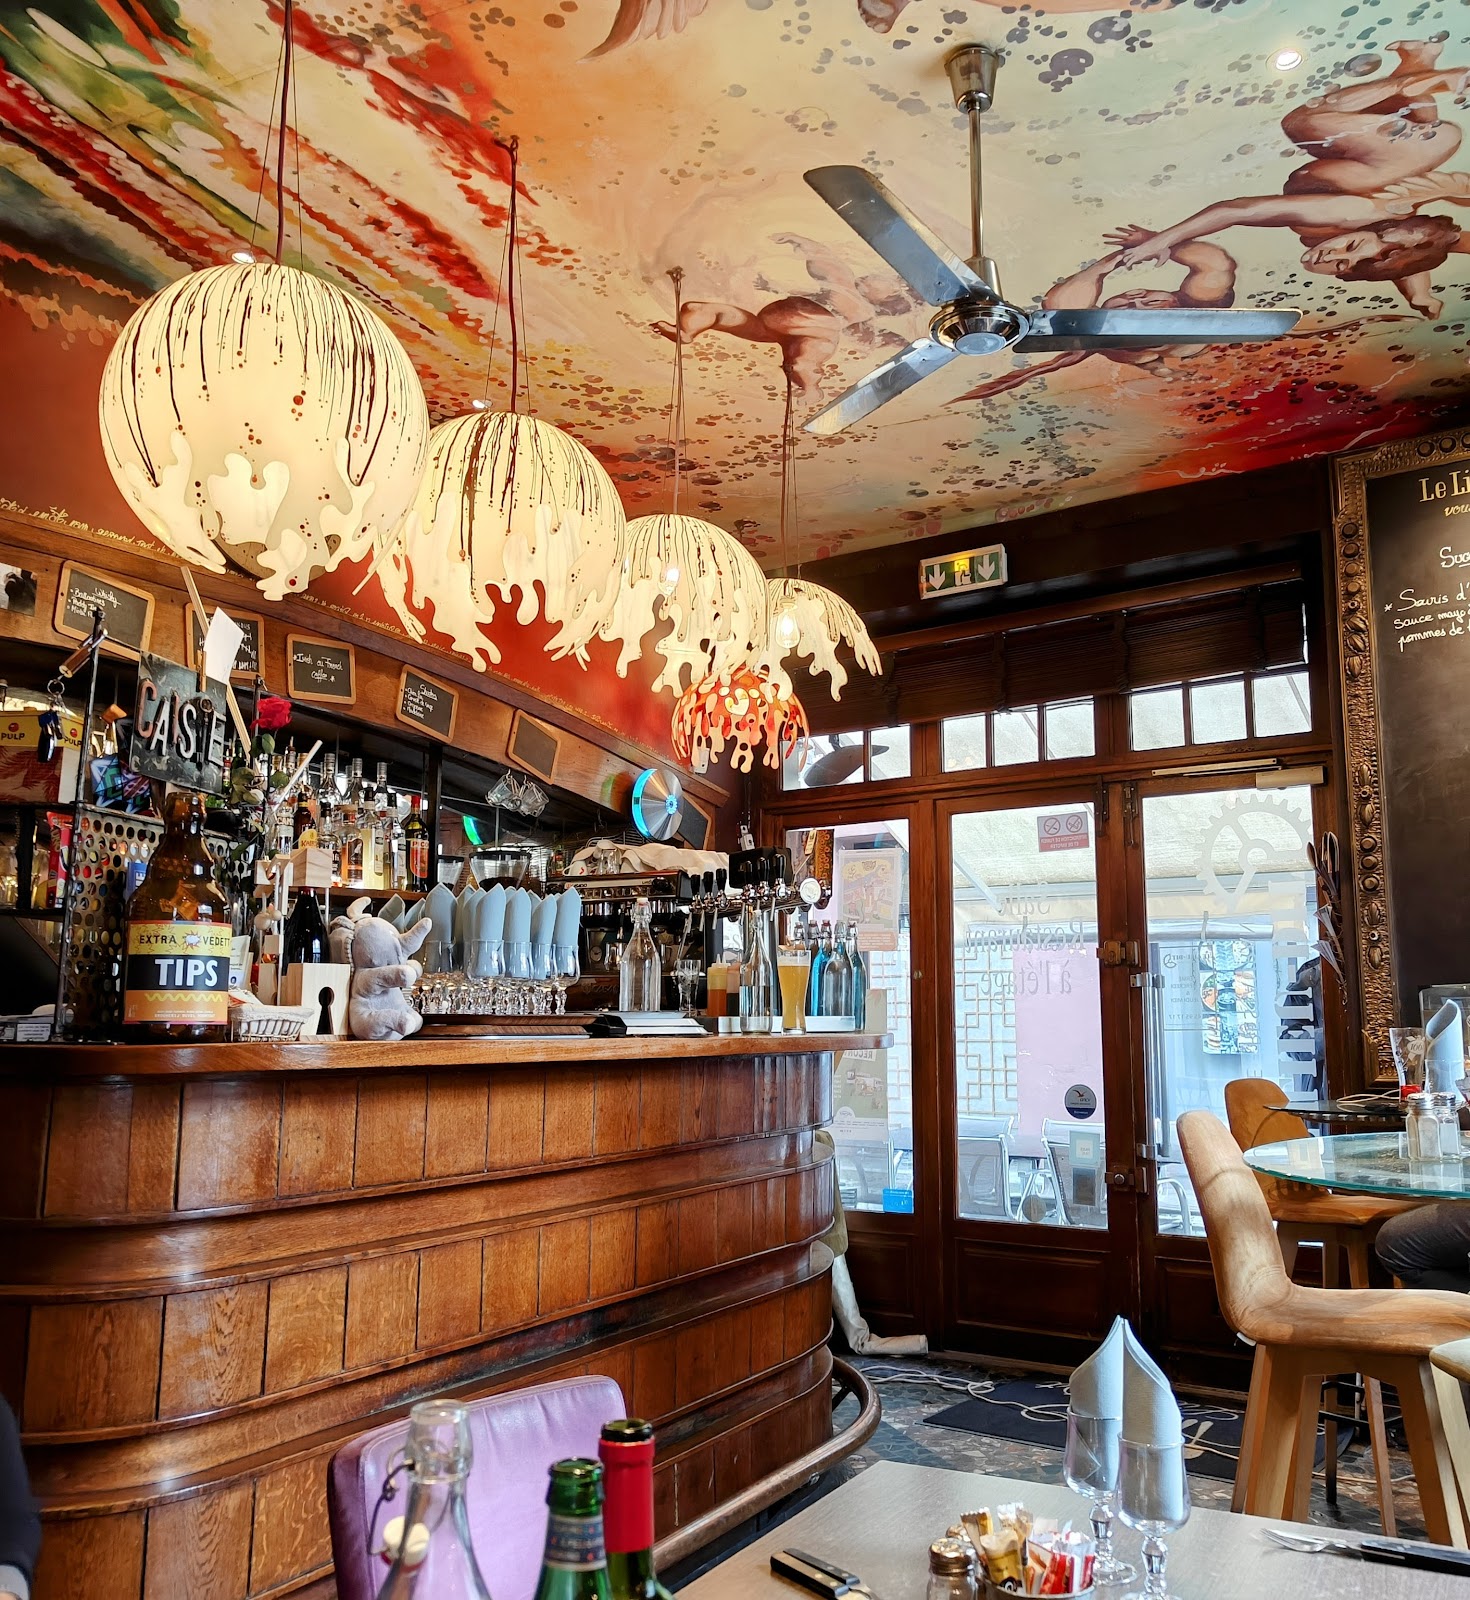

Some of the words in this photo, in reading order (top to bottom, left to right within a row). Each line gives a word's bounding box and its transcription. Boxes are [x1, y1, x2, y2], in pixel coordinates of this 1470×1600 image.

[1418, 478, 1447, 502] Le
[1444, 504, 1470, 517] vou
[1394, 613, 1435, 629] sauce
[1437, 608, 1466, 623] mayo
[1397, 628, 1447, 652] pommes
[1449, 621, 1465, 636] de
[0, 732, 26, 741] PULP
[64, 735, 83, 747] PULP
[139, 934, 177, 945] EXTRA
[154, 958, 218, 987] TIPS
